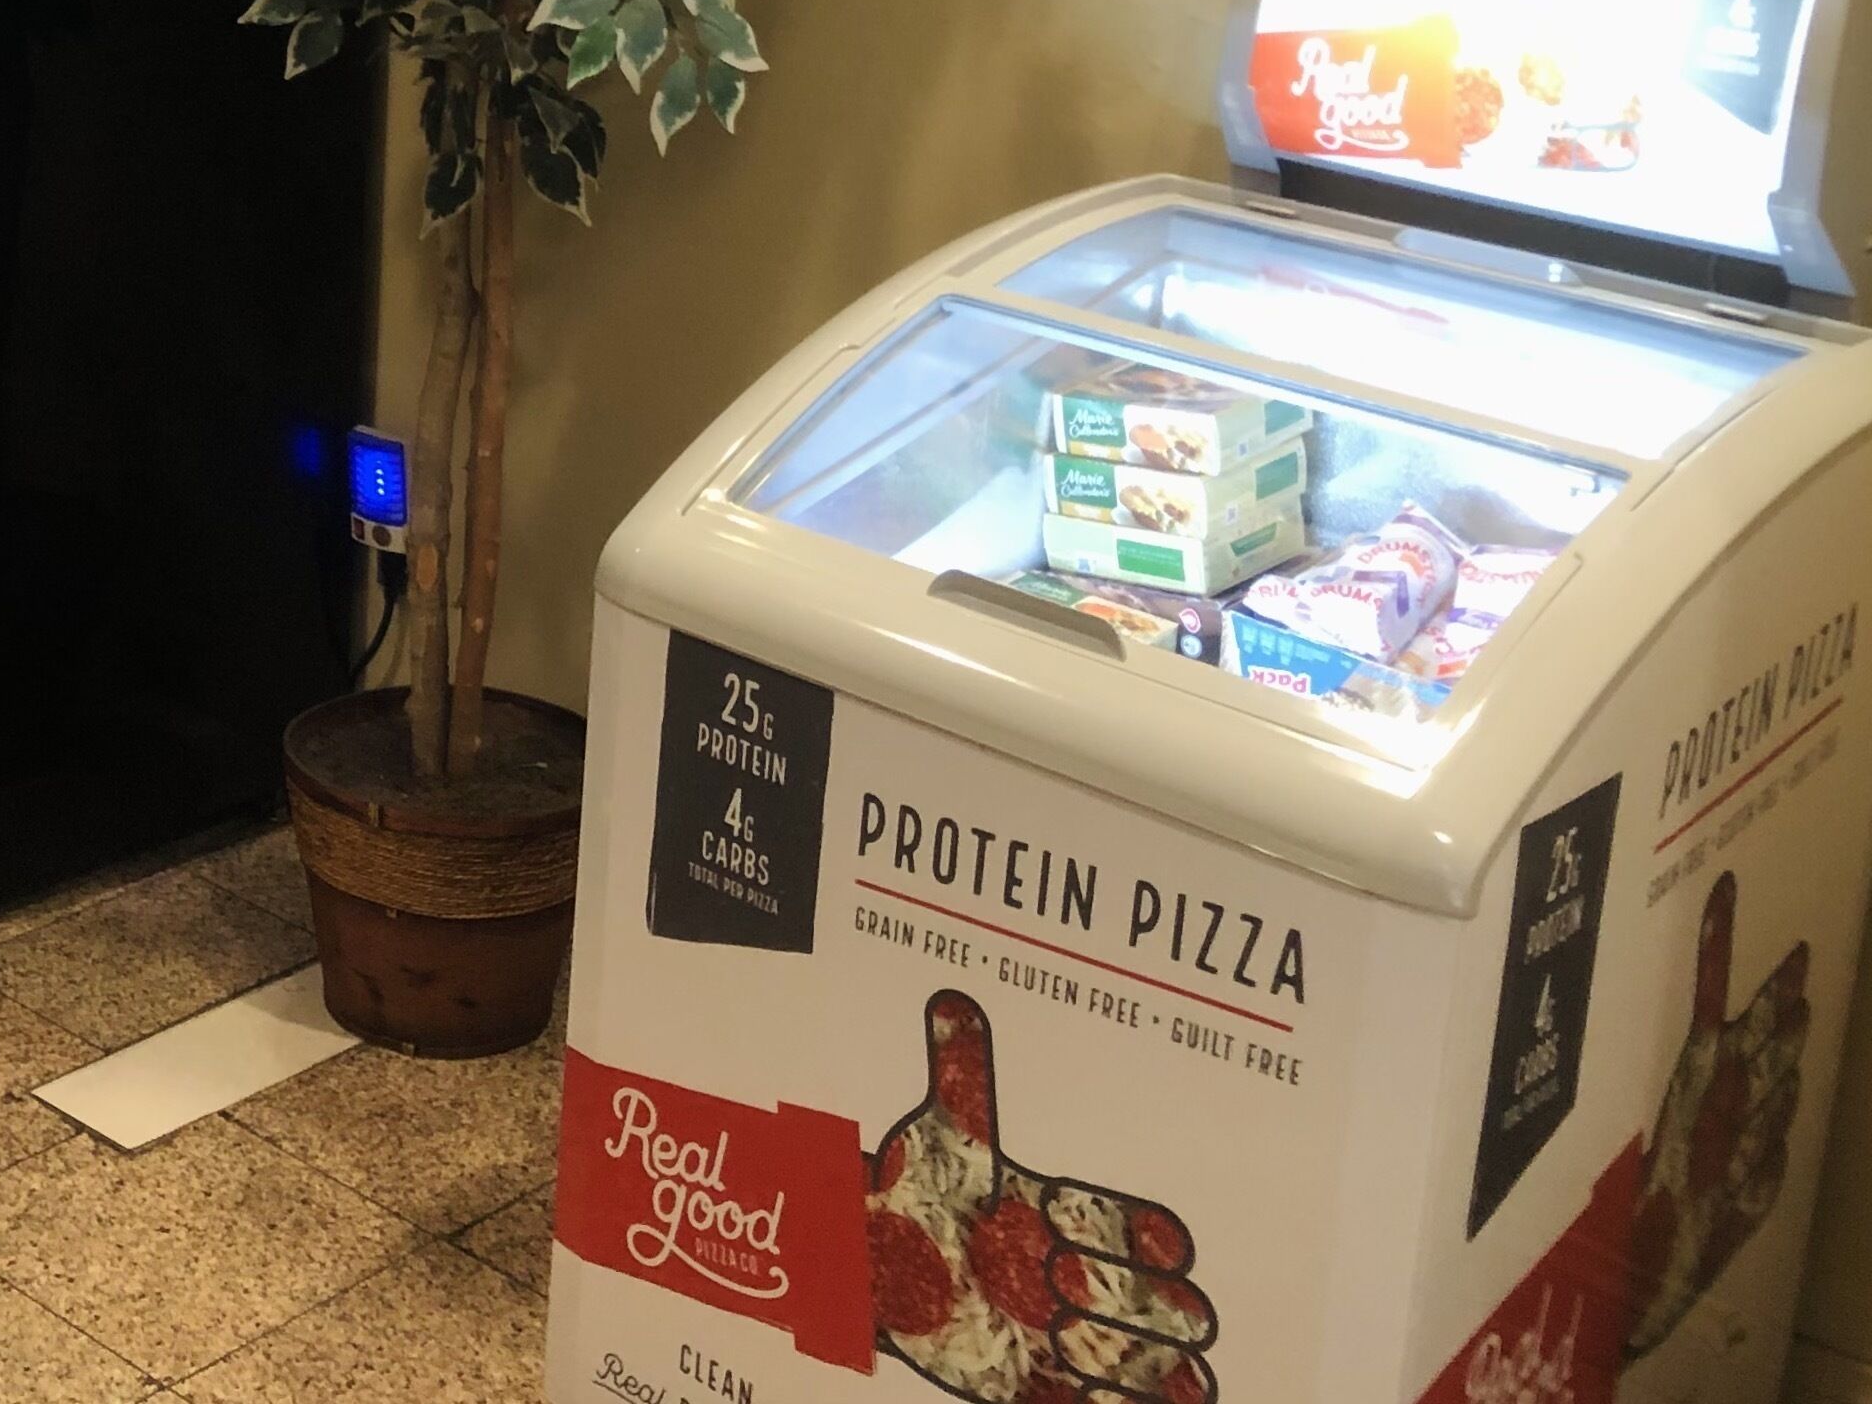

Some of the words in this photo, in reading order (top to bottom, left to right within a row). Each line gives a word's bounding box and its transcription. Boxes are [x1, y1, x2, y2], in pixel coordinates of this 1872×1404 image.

[1291, 37, 1377, 102] Real
[1314, 73, 1410, 152] good
[1060, 468, 1105, 487] Marie
[720, 672, 775, 741] 25G
[1250, 669, 1308, 694] Pack
[1658, 662, 1780, 821] PROTEIN
[1782, 600, 1858, 721] PIZZA
[696, 722, 788, 786] PROTEIN
[723, 787, 755, 843] 4G
[687, 861, 720, 890] TOTAL
[722, 875, 745, 898] PER
[746, 886, 780, 916] PIZZA
[701, 830, 770, 887] CARBS
[857, 791, 1098, 932] PROTEIN
[1127, 878, 1306, 1005] PIZZA
[853, 905, 916, 949] GRAIN
[922, 928, 971, 969] FREE
[997, 955, 1079, 1007] GLUTEN
[1087, 987, 1141, 1029] FREE
[1170, 1015, 1236, 1062] GUILT
[1245, 1042, 1303, 1087] FREE
[604, 1087, 729, 1193] Real
[626, 1178, 790, 1300] good
[694, 1236, 737, 1268] PIZZA
[679, 1343, 754, 1404] CLEAN
